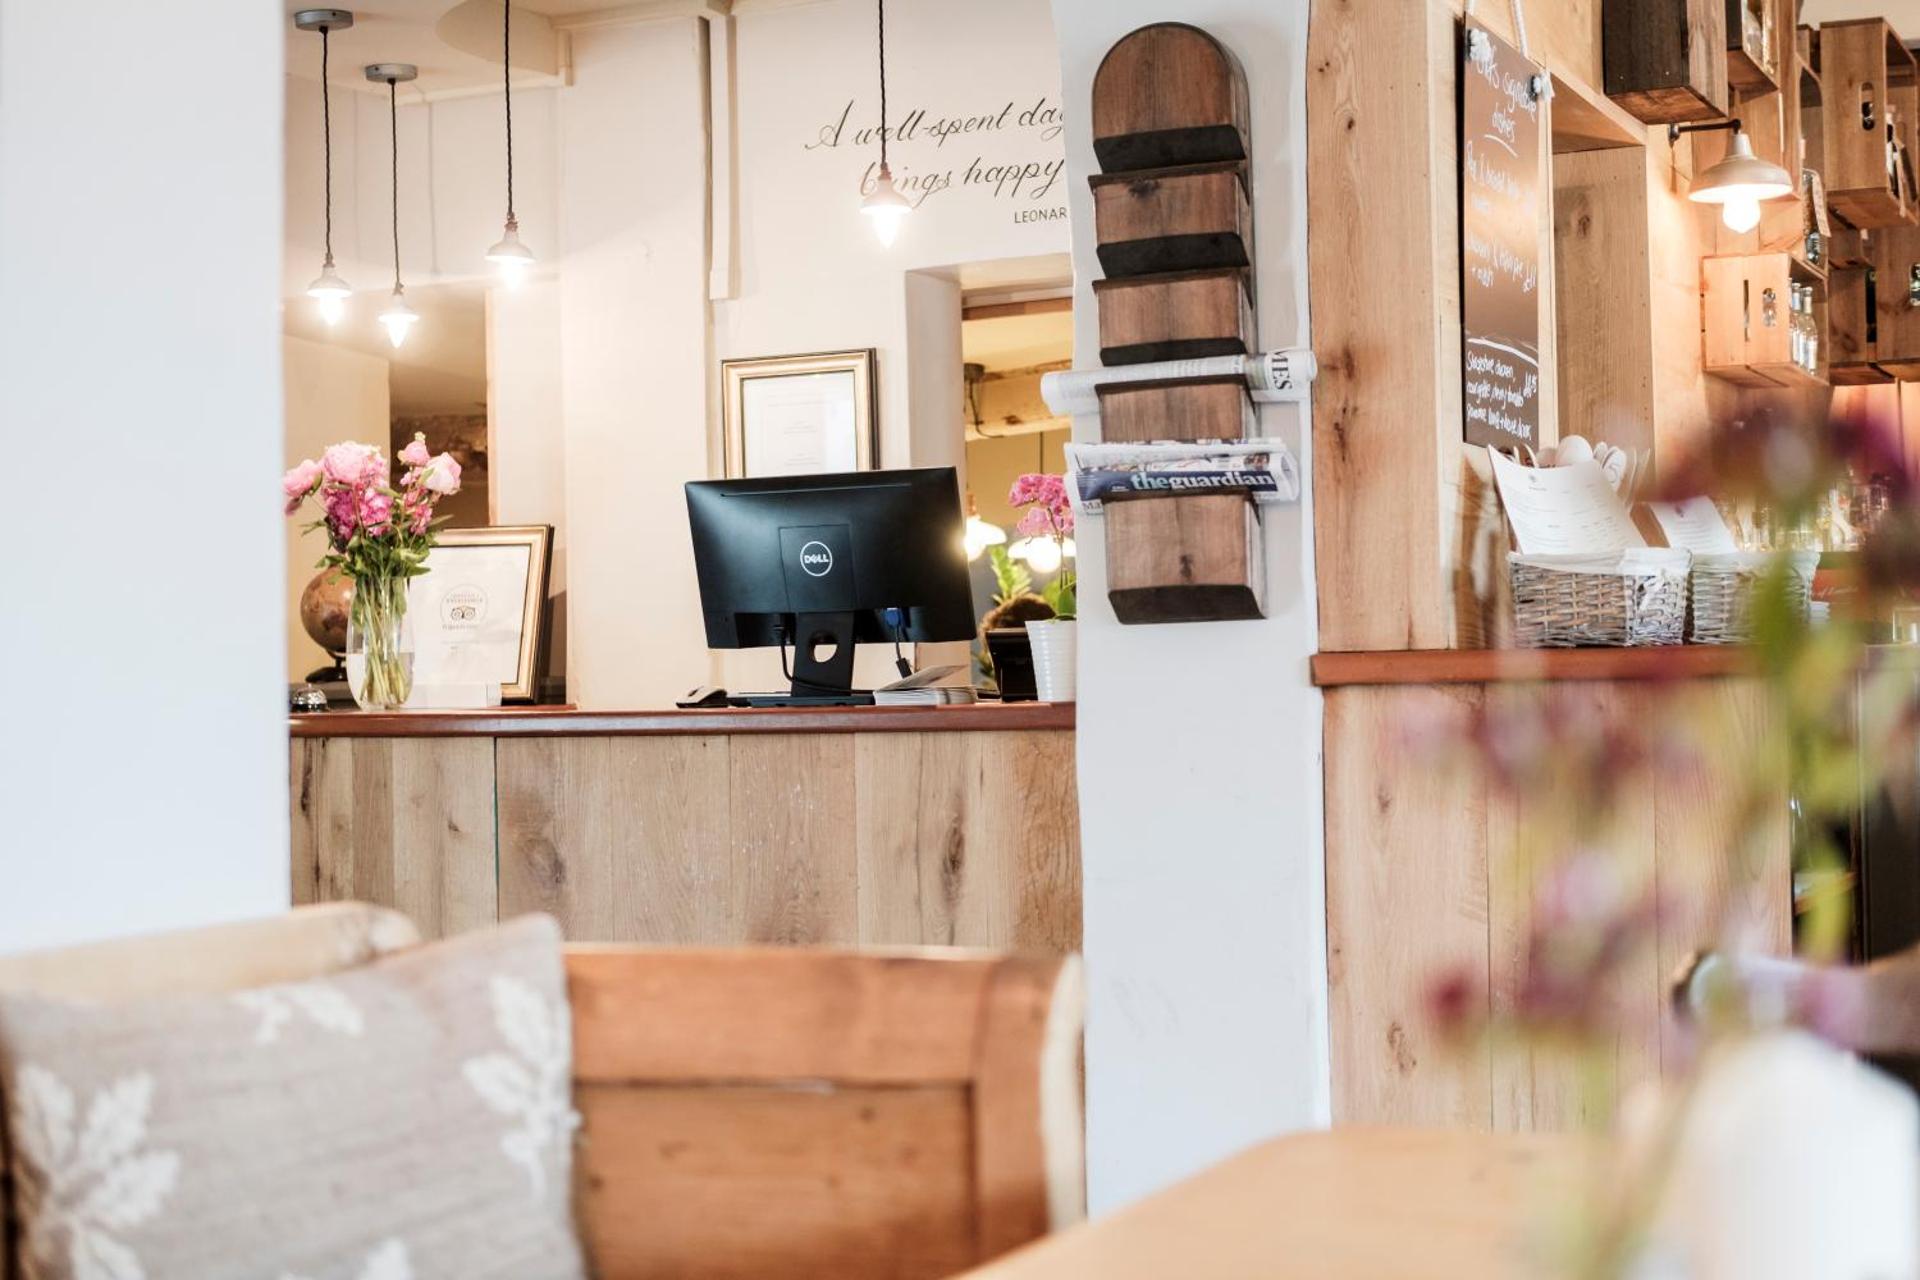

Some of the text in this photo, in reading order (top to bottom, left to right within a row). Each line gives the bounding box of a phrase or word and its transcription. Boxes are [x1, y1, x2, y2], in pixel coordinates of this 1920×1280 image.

[804, 99, 854, 150] A
[854, 101, 1014, 149] well-spent
[860, 156, 1065, 209] bings happy
[804, 553, 829, 564] DELL
